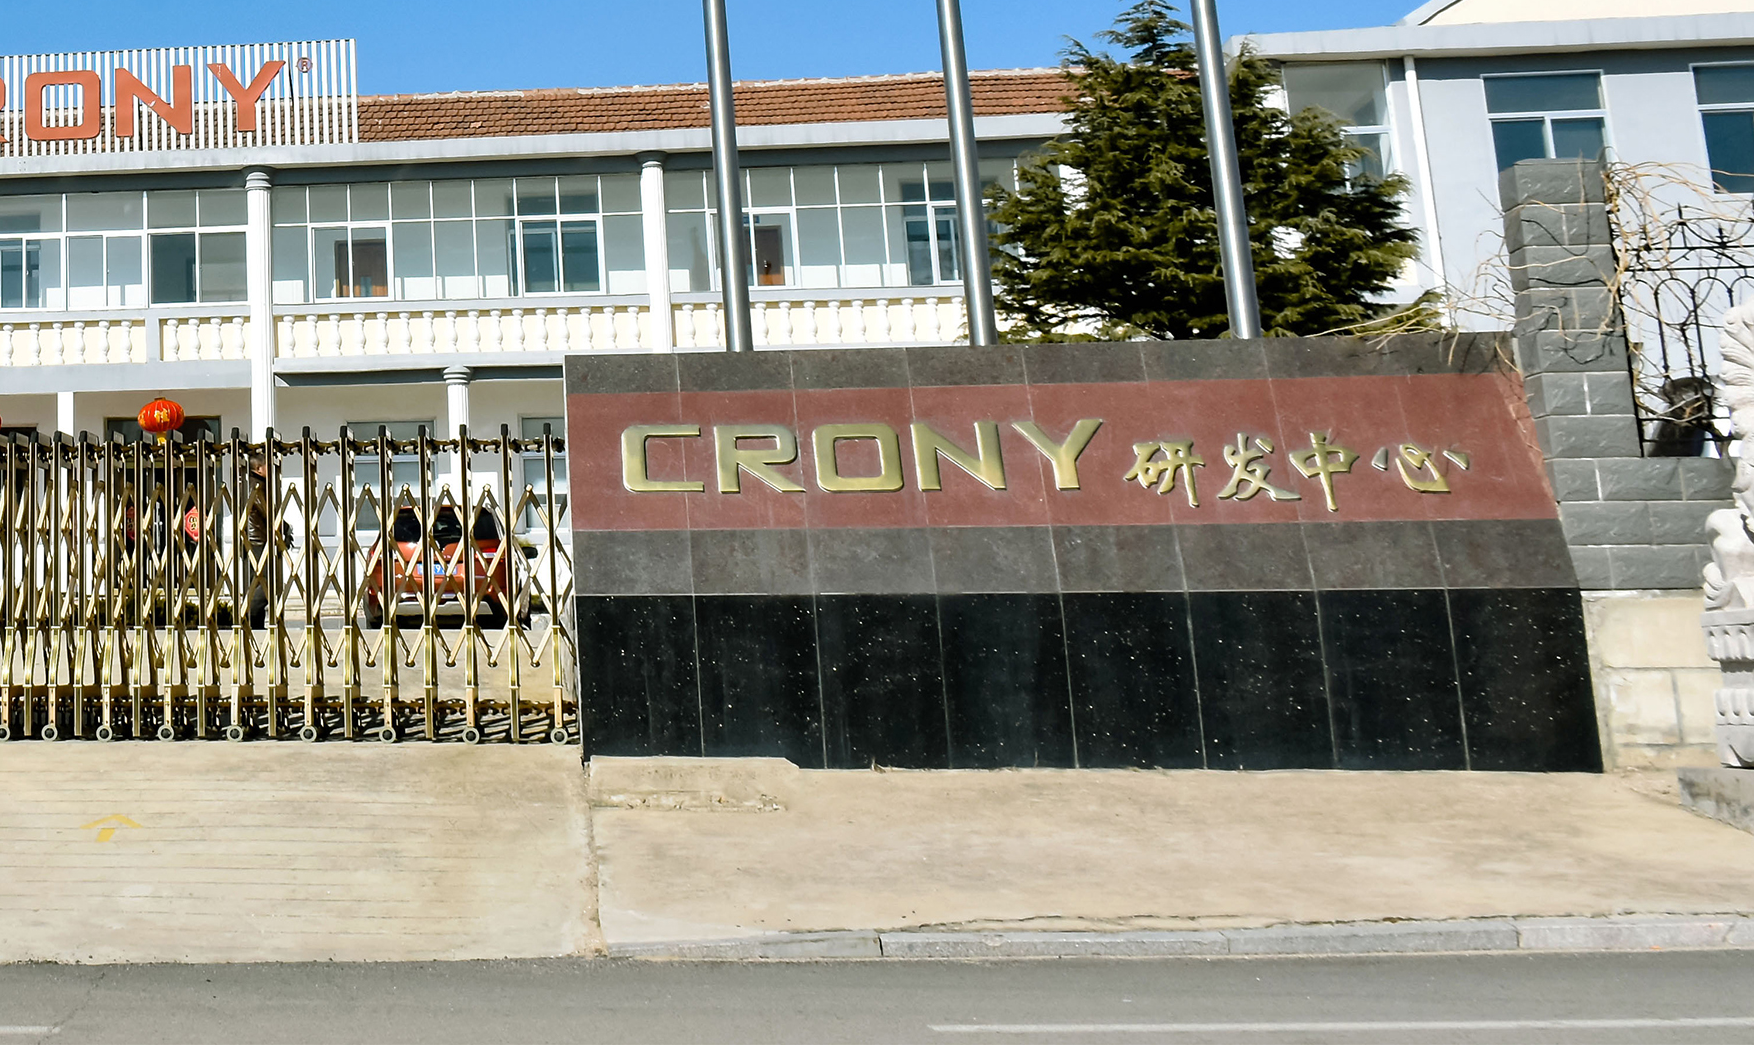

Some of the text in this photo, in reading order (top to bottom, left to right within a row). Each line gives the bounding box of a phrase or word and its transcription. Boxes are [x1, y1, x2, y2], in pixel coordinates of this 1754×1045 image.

[621, 419, 1470, 512] CRONY 研发中心
